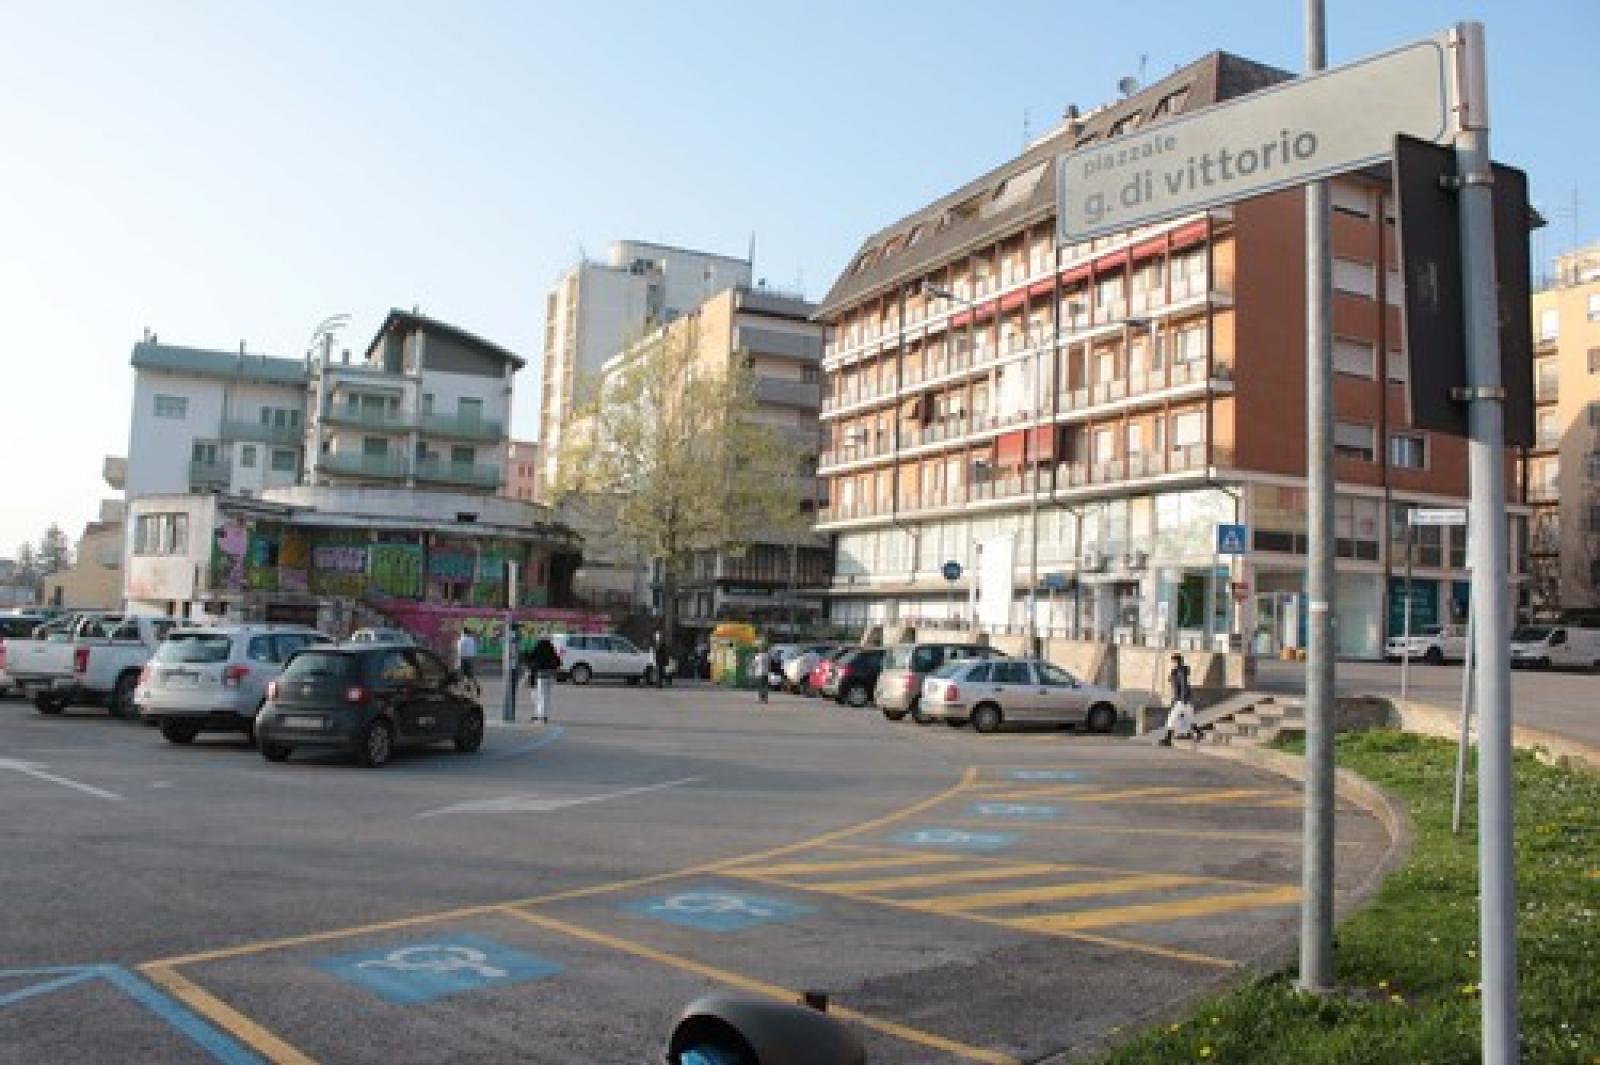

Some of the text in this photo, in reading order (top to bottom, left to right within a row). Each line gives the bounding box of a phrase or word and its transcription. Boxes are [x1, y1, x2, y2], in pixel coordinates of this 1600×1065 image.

[1084, 134, 1177, 178] piazzale
[1084, 130, 1318, 224] g. di vittorio
